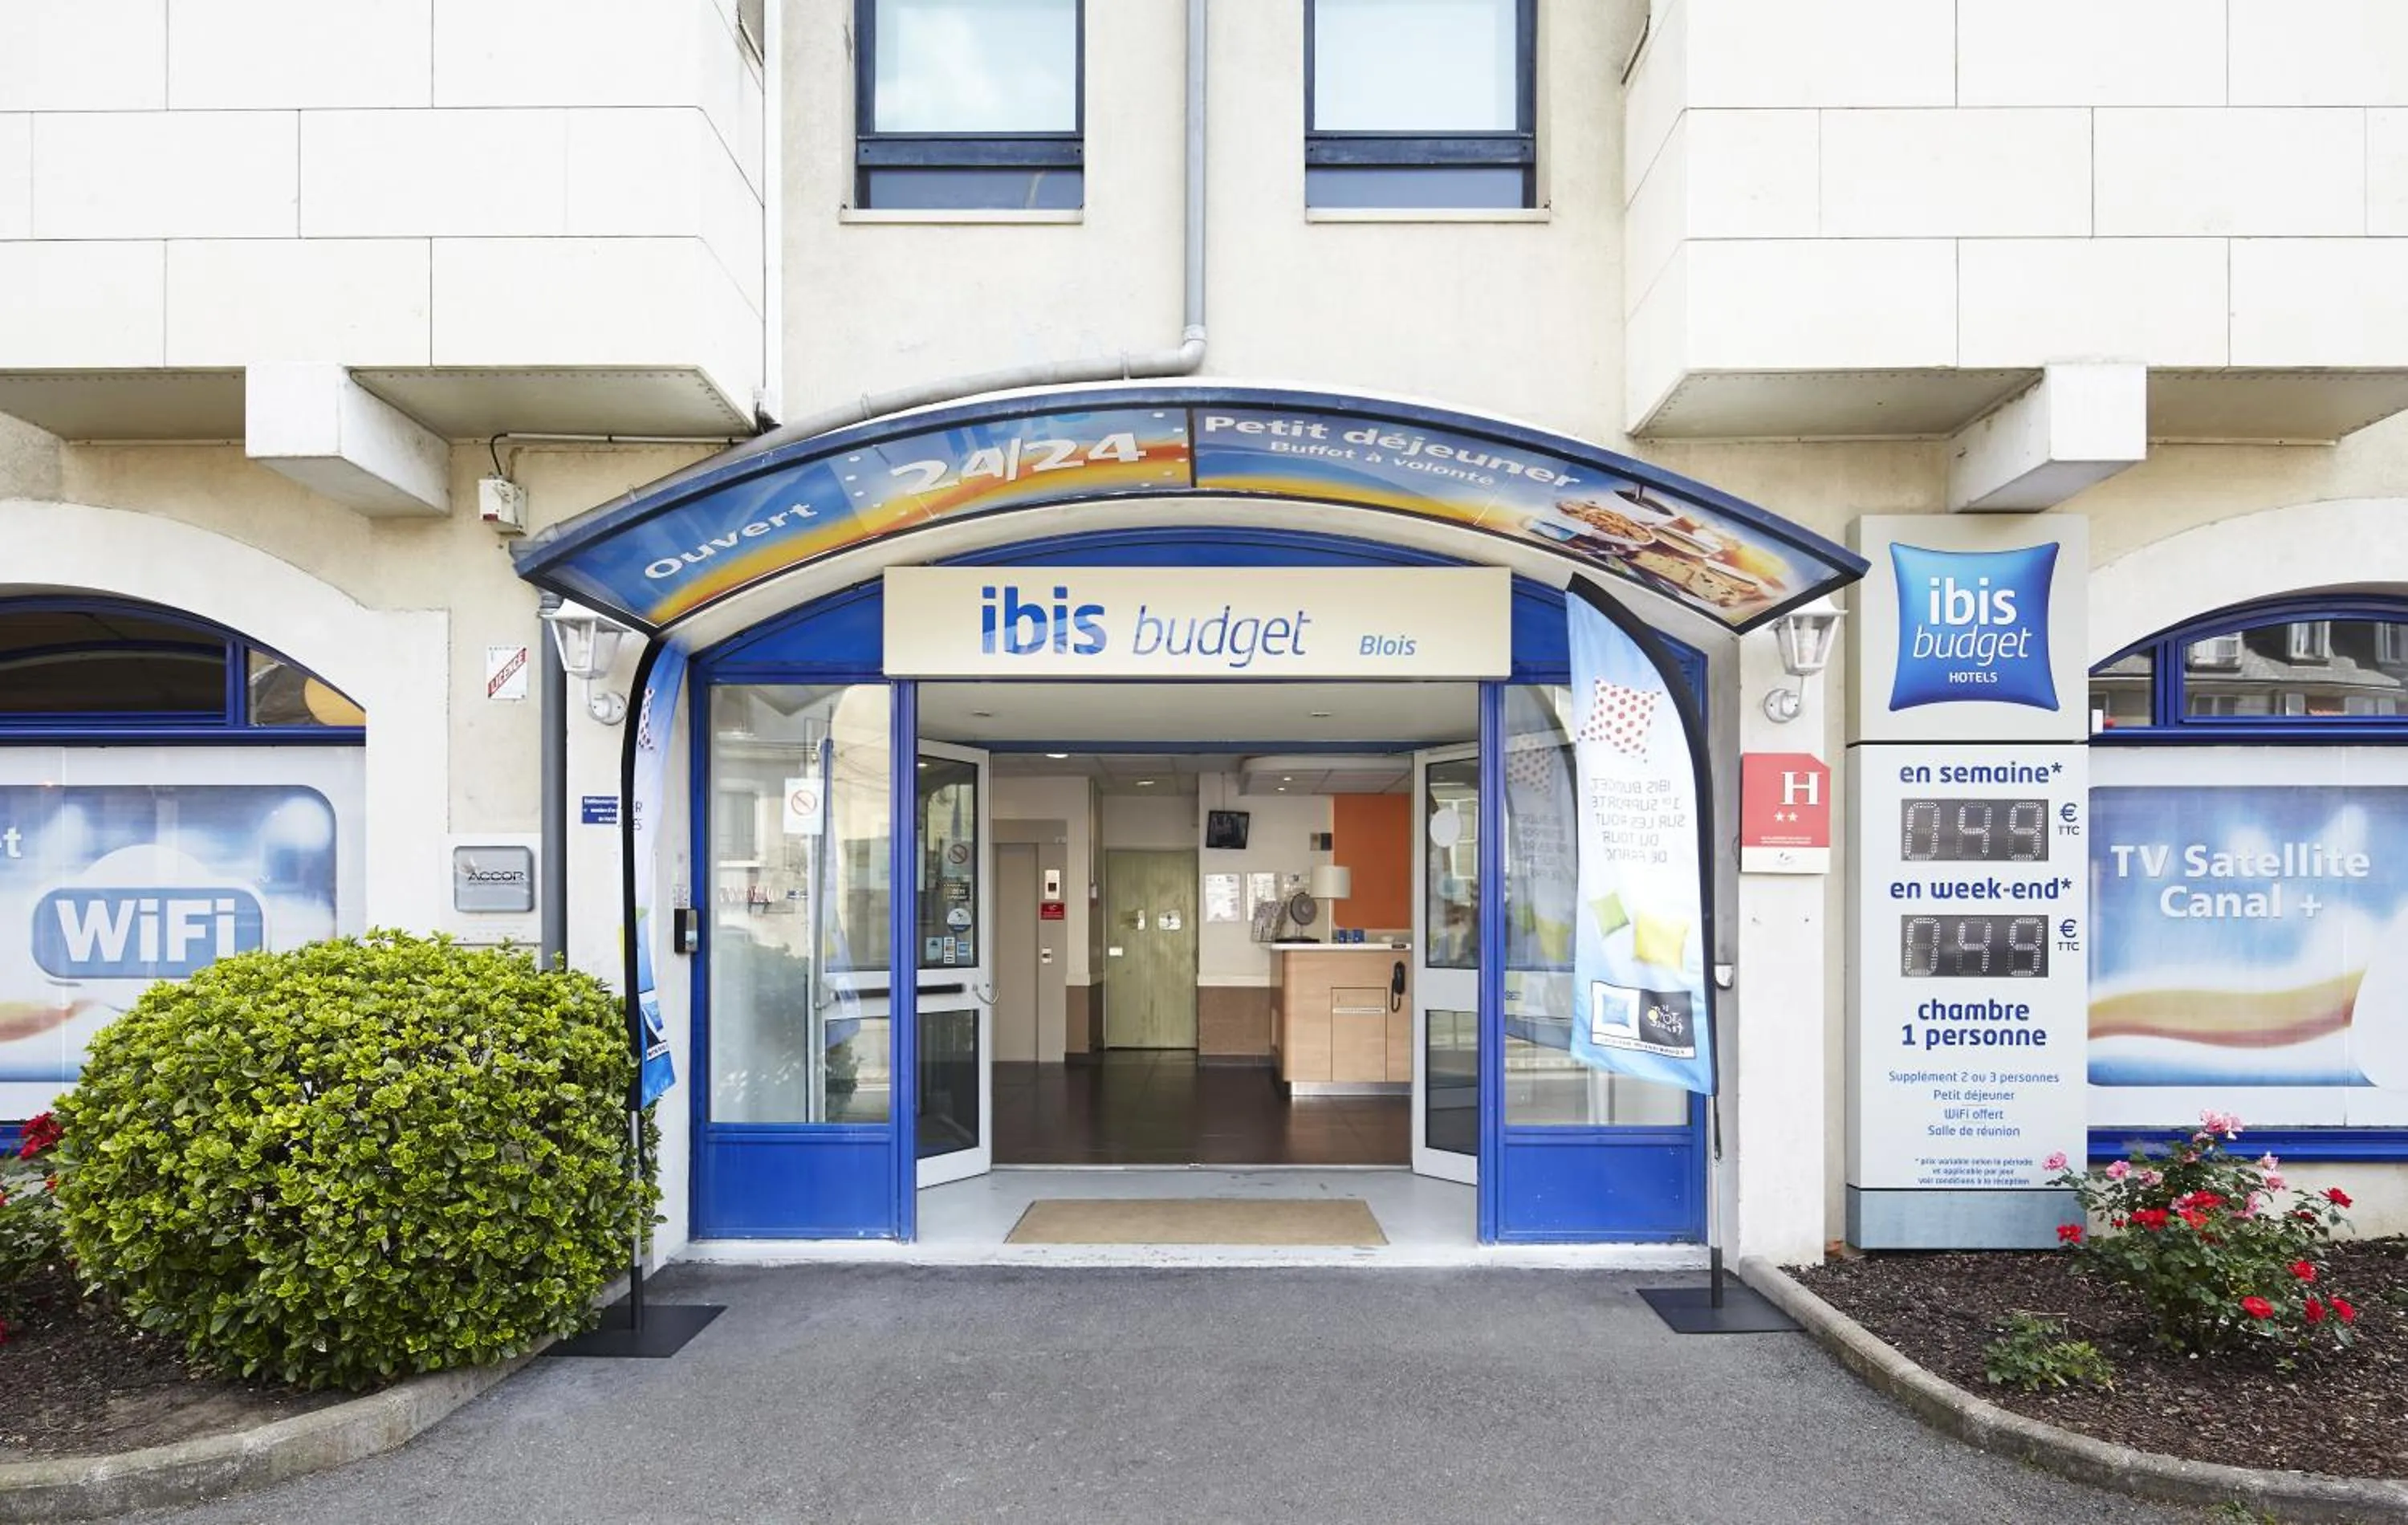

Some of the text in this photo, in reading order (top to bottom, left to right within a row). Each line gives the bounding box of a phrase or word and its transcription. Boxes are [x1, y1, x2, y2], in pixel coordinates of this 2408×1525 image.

[1204, 415, 1581, 488] Petit déjeuner
[890, 432, 1147, 496] 24/24
[1365, 450, 1381, 463] à
[1393, 457, 1495, 486] volonté
[645, 502, 820, 580] Ouvert
[1930, 576, 2017, 625] ibis
[981, 585, 1417, 668] ibis budget Blois
[1913, 624, 2032, 666] budget
[1949, 672, 1998, 683] HOTELS
[1900, 766, 1930, 783] en
[1780, 771, 1824, 805] H
[2060, 803, 2079, 823] €
[2058, 825, 2080, 836] TTC
[2111, 842, 2371, 878] TV Satellite
[468, 870, 524, 881] ACCOR
[1890, 882, 1921, 899] en
[2160, 883, 2322, 918] Canal +
[55, 898, 236, 962] WiFi
[2060, 918, 2079, 939] €
[2058, 941, 2080, 951] TTC
[1918, 998, 2030, 1022] chambre
[1902, 1024, 2047, 1051] 1 personne
[1889, 1070, 2060, 1084] Supplément 2 ou 3 personnes
[1934, 1089, 2015, 1102] Petit déjeuner
[1944, 1108, 2003, 1120] WiFi offert
[1928, 1125, 2020, 1137] Salle de réunion
